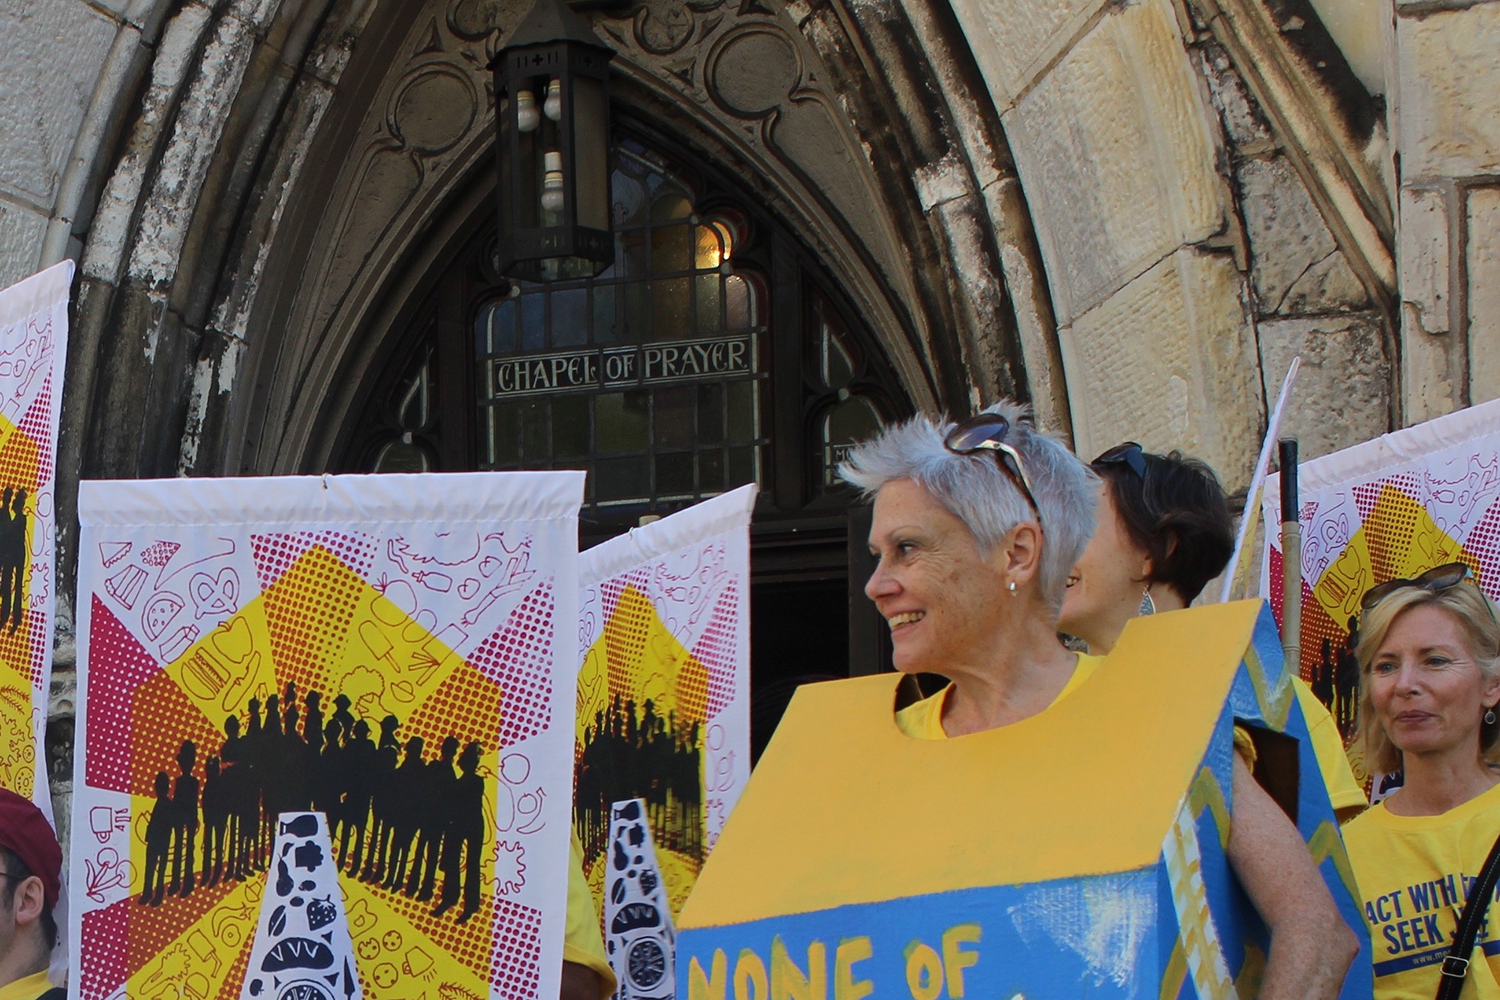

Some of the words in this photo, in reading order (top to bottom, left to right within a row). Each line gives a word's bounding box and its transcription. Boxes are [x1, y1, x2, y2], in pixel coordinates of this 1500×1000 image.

[497, 355, 599, 391] CHAPEL
[606, 354, 634, 380] OF
[645, 341, 748, 378] PRAYER
[1365, 890, 1402, 926] ACT
[1407, 874, 1458, 913] WITH
[1383, 913, 1445, 955] SEEK
